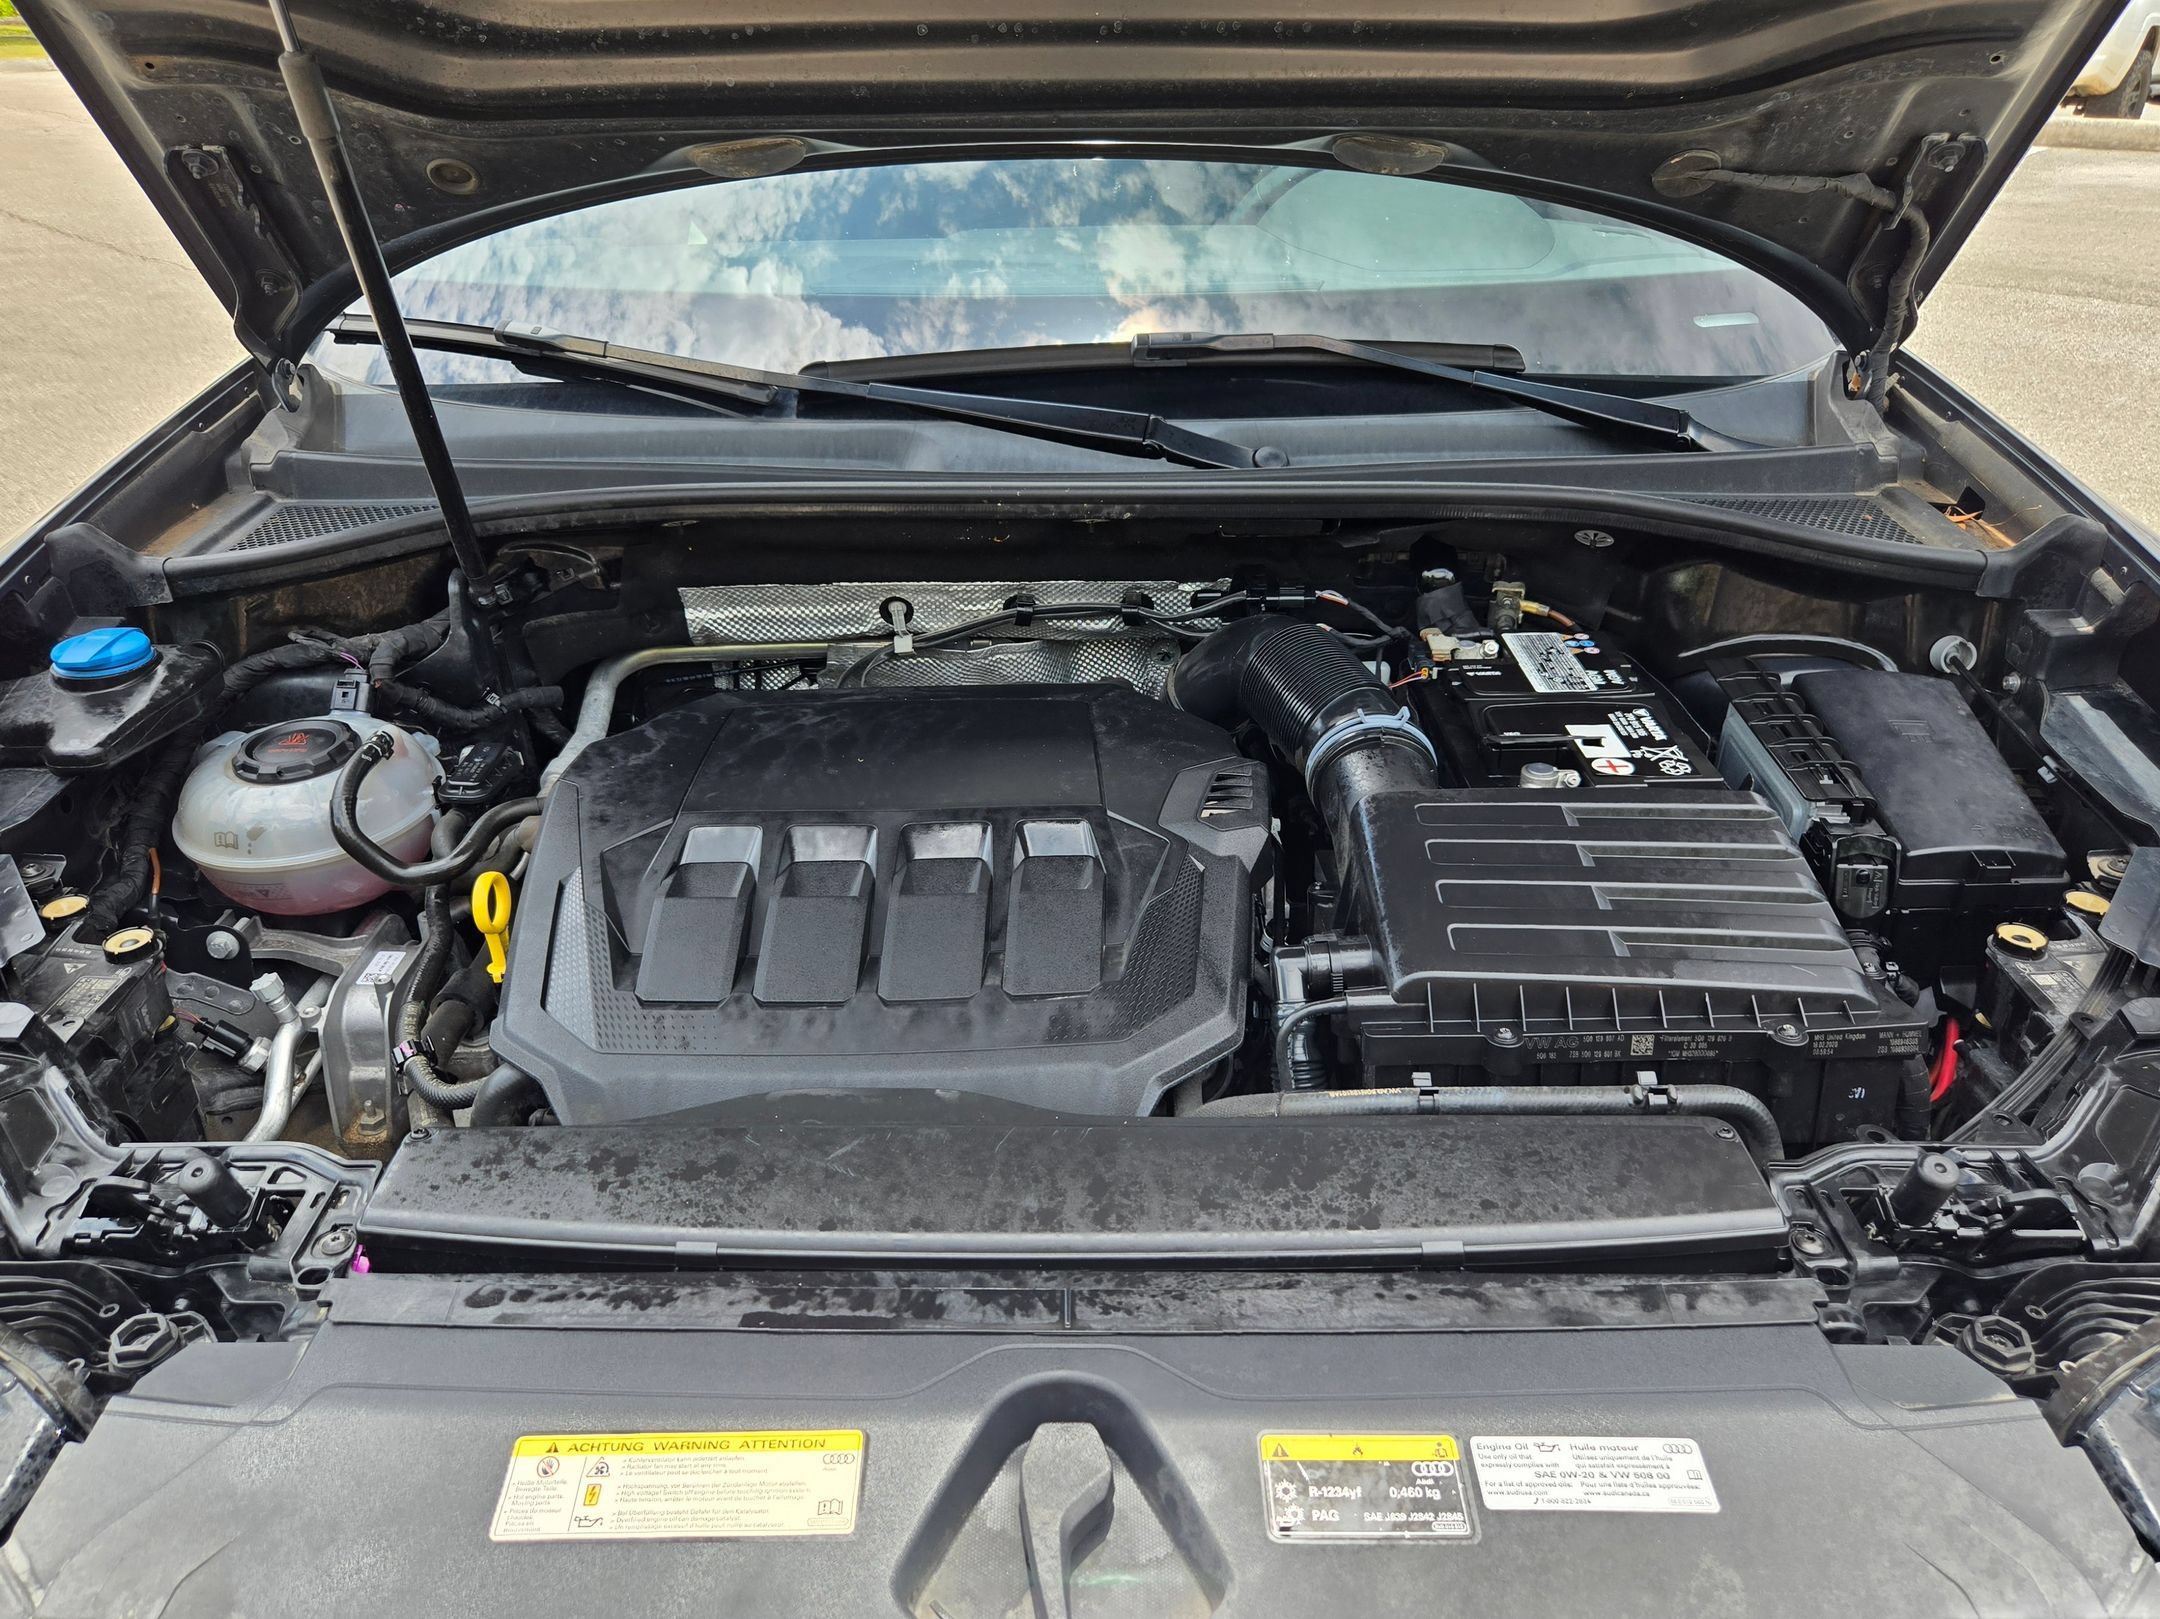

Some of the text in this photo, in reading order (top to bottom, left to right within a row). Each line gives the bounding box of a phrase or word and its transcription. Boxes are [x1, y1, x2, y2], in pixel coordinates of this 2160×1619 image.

[1524, 1036, 1579, 1049] VW AG
[567, 1438, 826, 1452] ACHTUNG WARNING ATTENTION
[1476, 1442, 1529, 1452] Engine Oil
[1569, 1443, 1596, 1451] Huile
[1534, 1470, 1671, 1480] SAE 0W-20 & VW 508 00
[1308, 1486, 1362, 1500] R-1234yf
[1425, 1486, 1442, 1501] kg
[1311, 1509, 1340, 1522] PAG
[1363, 1512, 1384, 1522] SAE
